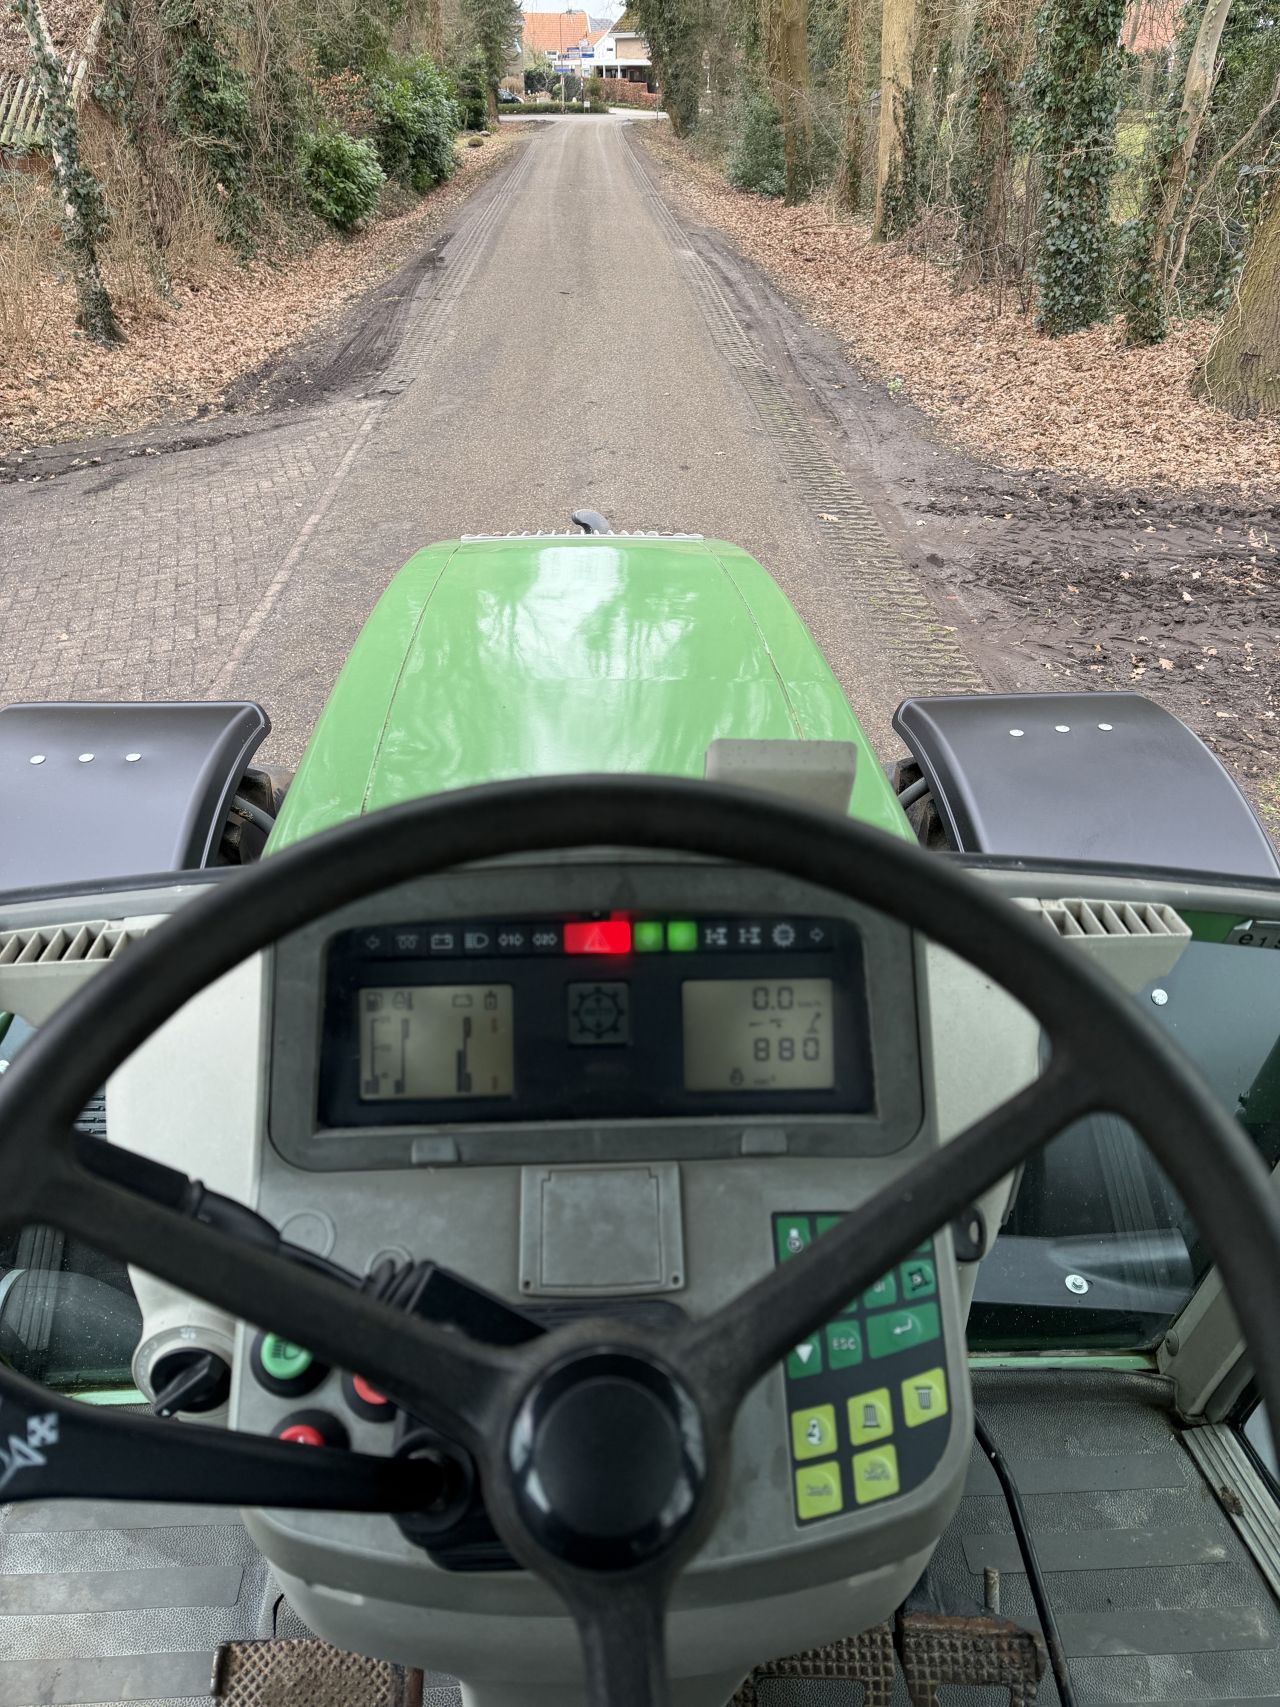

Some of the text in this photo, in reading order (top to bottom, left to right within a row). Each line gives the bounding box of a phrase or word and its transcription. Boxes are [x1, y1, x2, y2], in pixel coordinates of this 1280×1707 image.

[752, 985, 795, 1011] 0.0
[753, 1037, 820, 1062] 880
[832, 1336, 857, 1350] ESC
